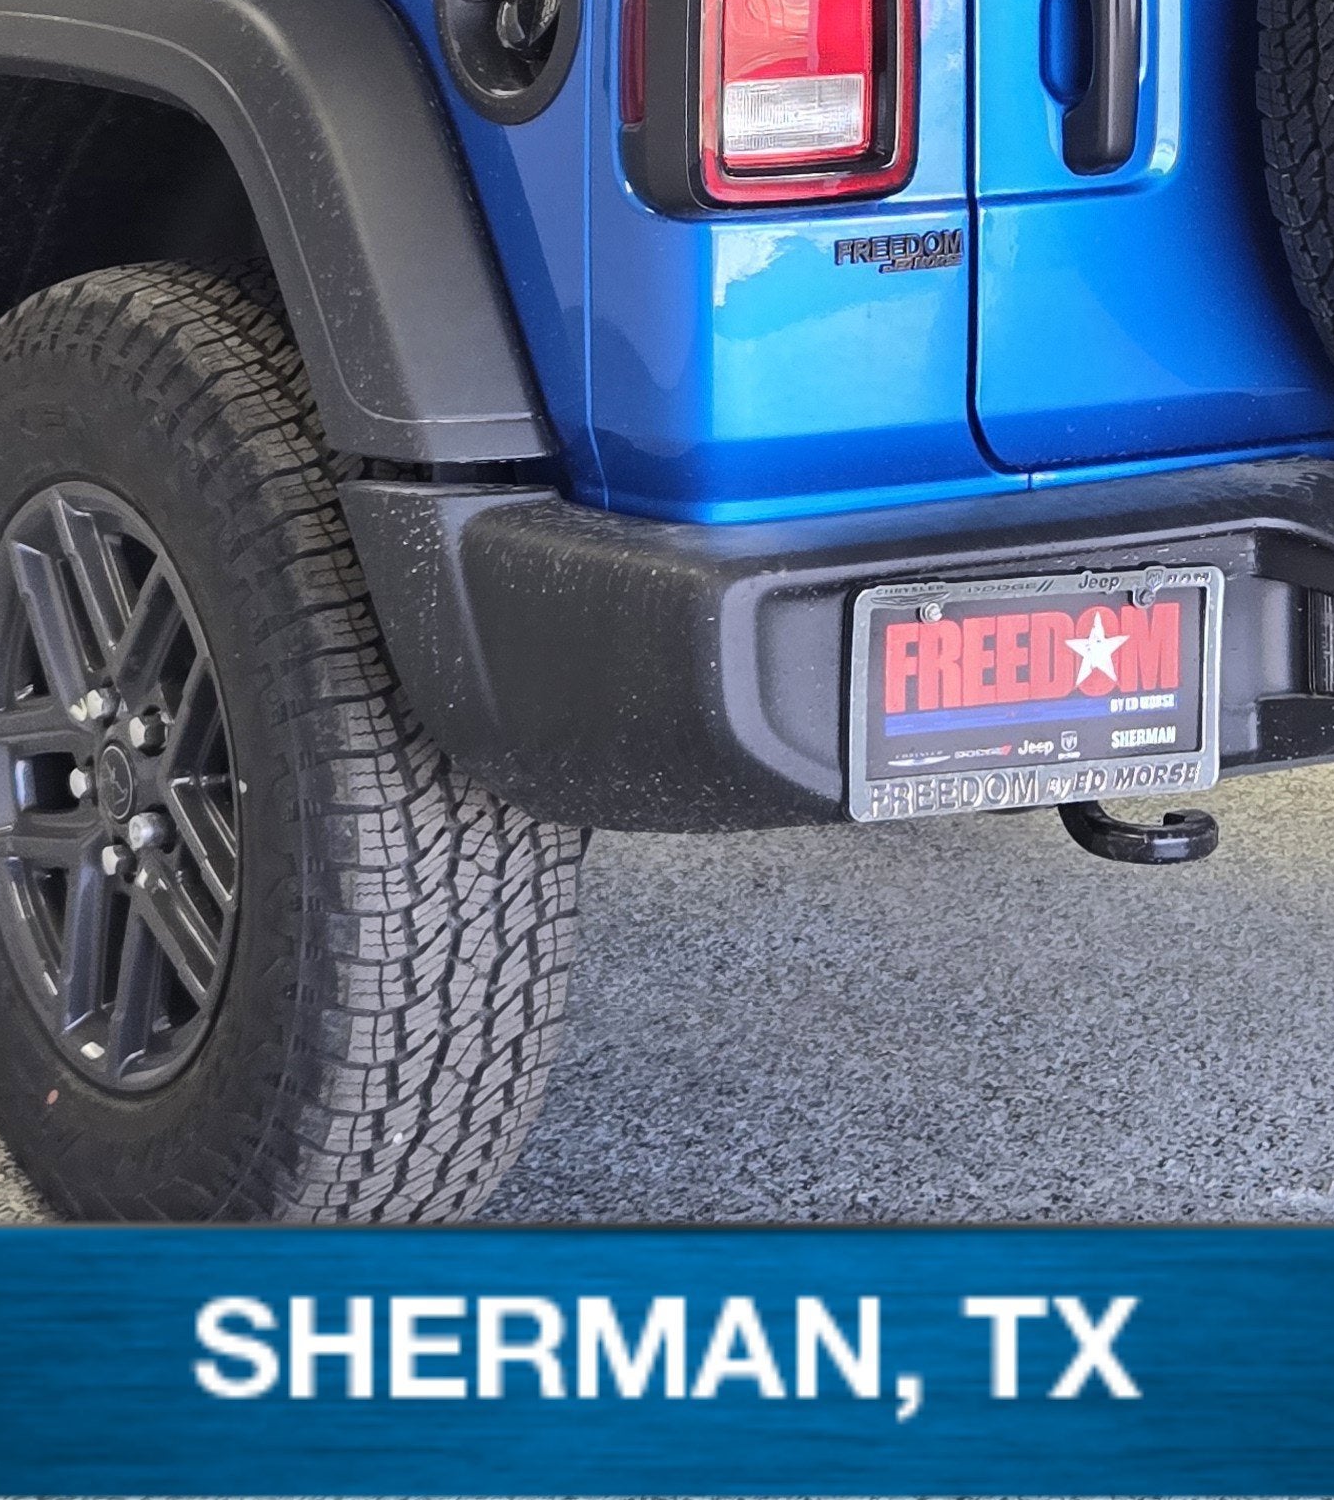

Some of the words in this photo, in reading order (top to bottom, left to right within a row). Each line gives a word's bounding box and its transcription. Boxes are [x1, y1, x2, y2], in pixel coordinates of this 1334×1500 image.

[834, 228, 964, 266] FREEDOM
[875, 583, 946, 595] CHRYSLER
[967, 581, 1037, 594] DODGE
[1078, 573, 1121, 592] Jeep
[884, 602, 1181, 714] FREEDOM
[1017, 739, 1055, 756] Jeep
[1111, 725, 1176, 749] SHERMAN
[870, 770, 1040, 818] FREEDOM
[1073, 768, 1108, 794] ED
[1113, 761, 1202, 791] MORSE
